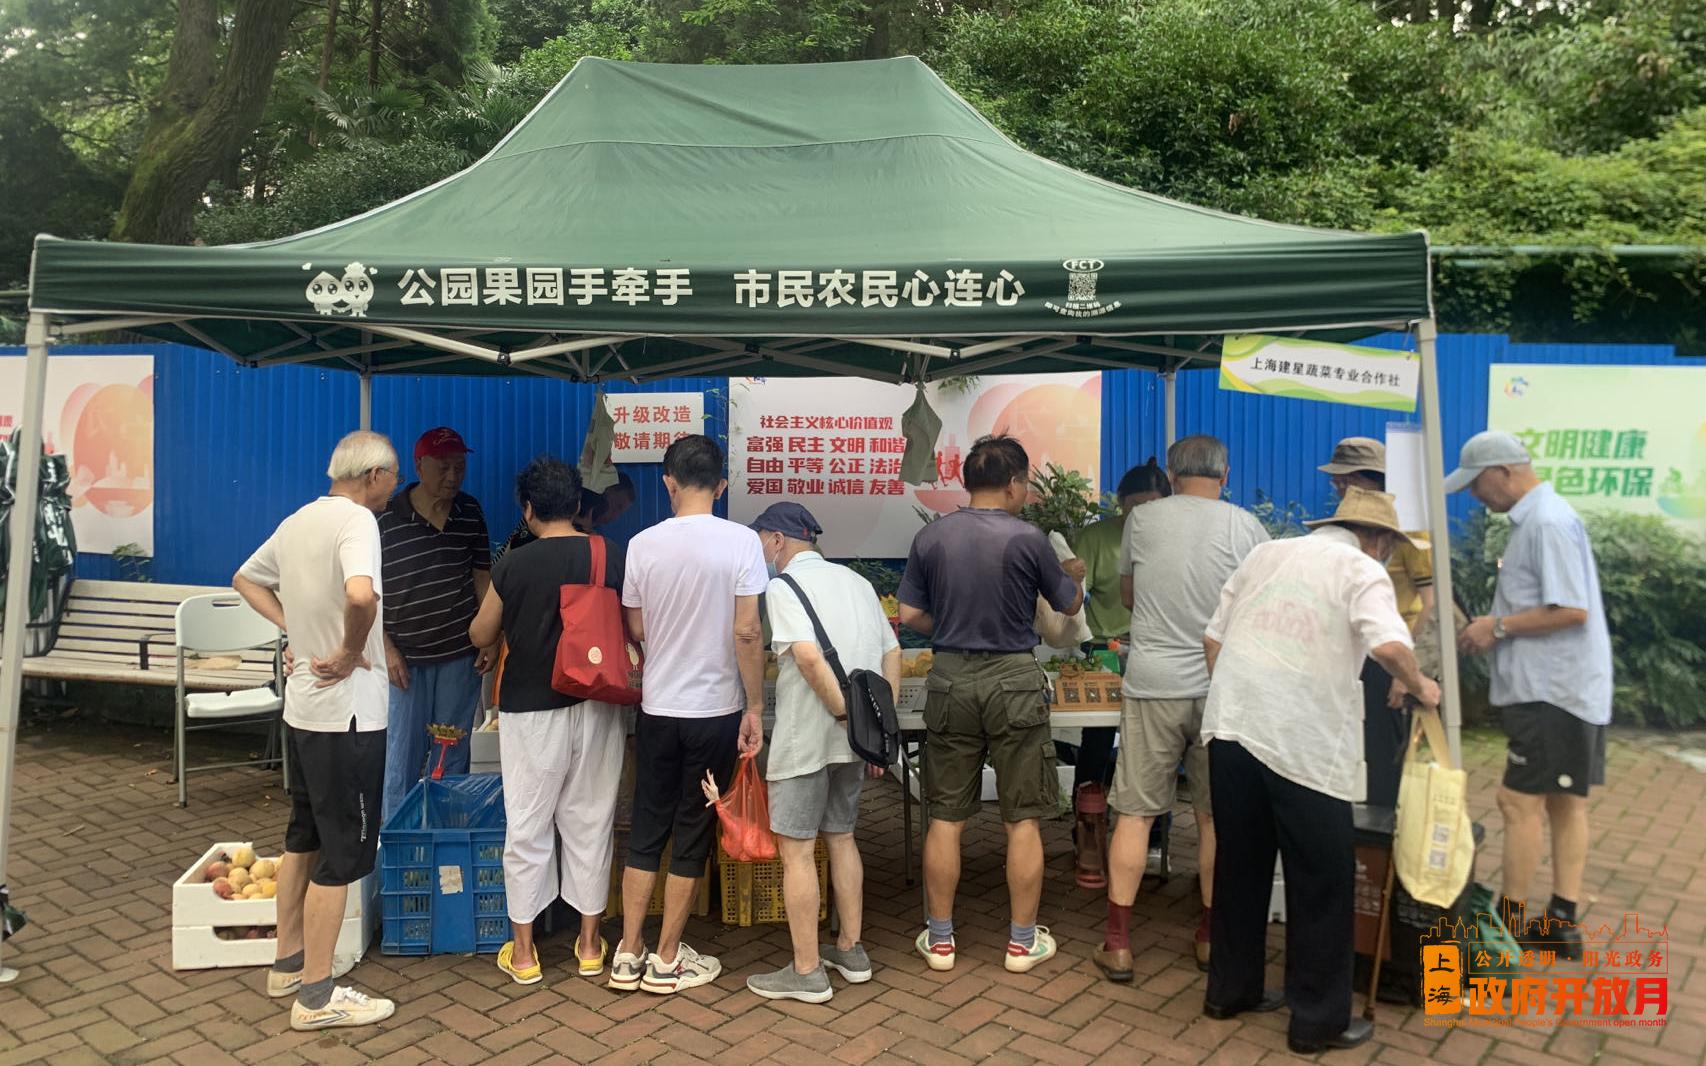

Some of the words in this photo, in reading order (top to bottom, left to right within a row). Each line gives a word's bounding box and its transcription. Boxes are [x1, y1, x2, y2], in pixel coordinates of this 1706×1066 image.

[1071, 260, 1096, 269] FCT
[397, 266, 694, 306] 公园果园手牵手
[733, 268, 1026, 308] 市民农民心连心
[1250, 356, 1401, 387] 上海建星蔬菜专业合作社
[613, 405, 692, 424] 升级改造
[759, 415, 894, 430] 社会主义核心价值观
[746, 436, 784, 453] 富强
[788, 436, 825, 453] 民主
[829, 436, 865, 453] 文明
[869, 436, 906, 453] 和谐
[1514, 427, 1648, 460] 文明健康
[746, 457, 784, 474] 自由
[788, 457, 825, 474] 平等
[829, 457, 865, 474] 公正
[869, 457, 901, 474] 法治
[746, 478, 784, 495] 爱国
[788, 478, 825, 495] 敬业
[829, 478, 865, 495] 诚信
[869, 478, 906, 495] 友善
